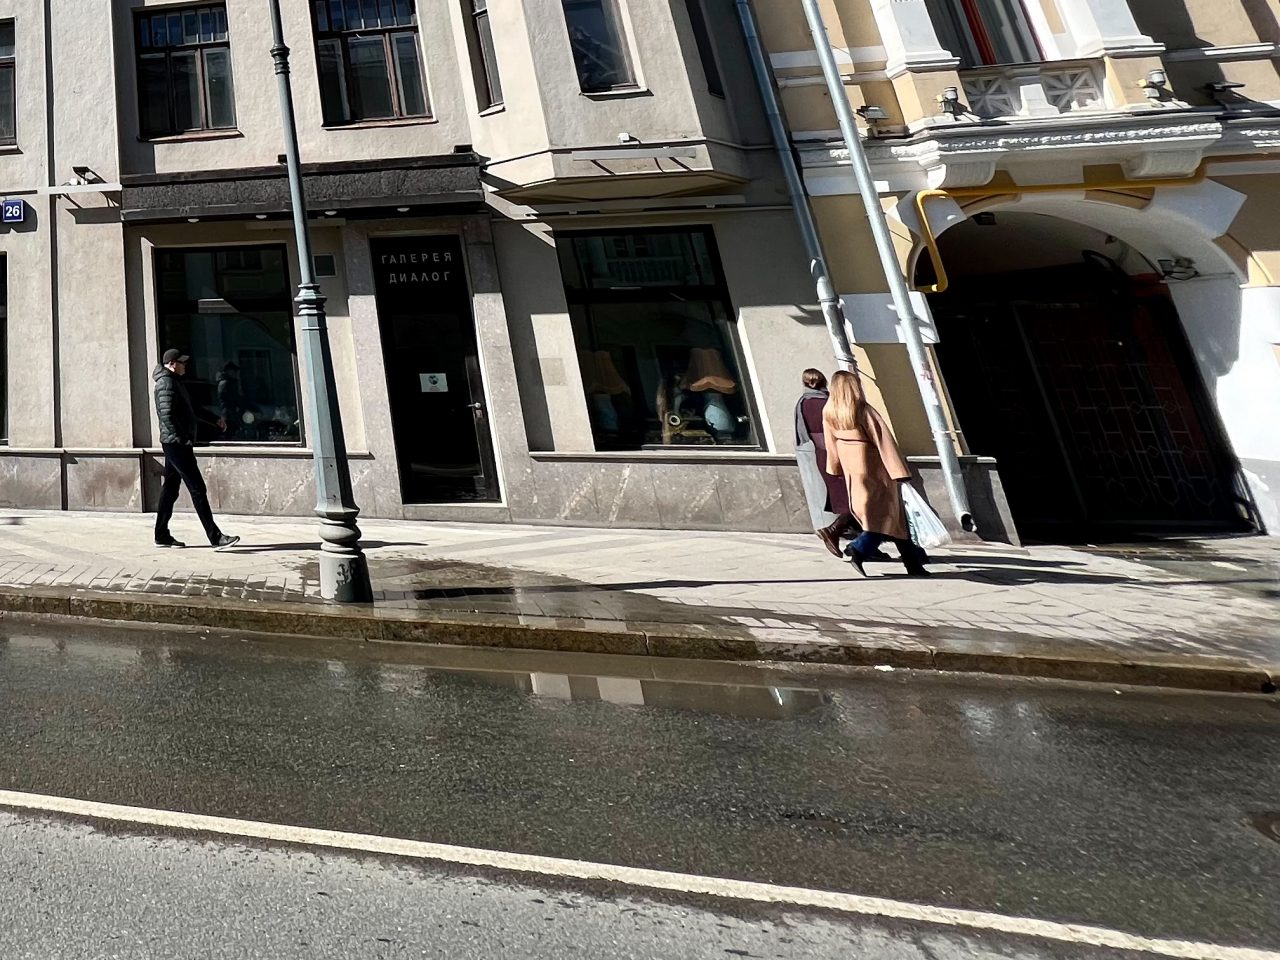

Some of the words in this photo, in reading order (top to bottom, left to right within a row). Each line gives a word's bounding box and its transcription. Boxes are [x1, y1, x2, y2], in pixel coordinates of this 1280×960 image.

[5, 205, 20, 217] 26
[381, 252, 452, 264] ГАЛЕРЕЯ
[389, 272, 450, 284] ДИАЛОГ
